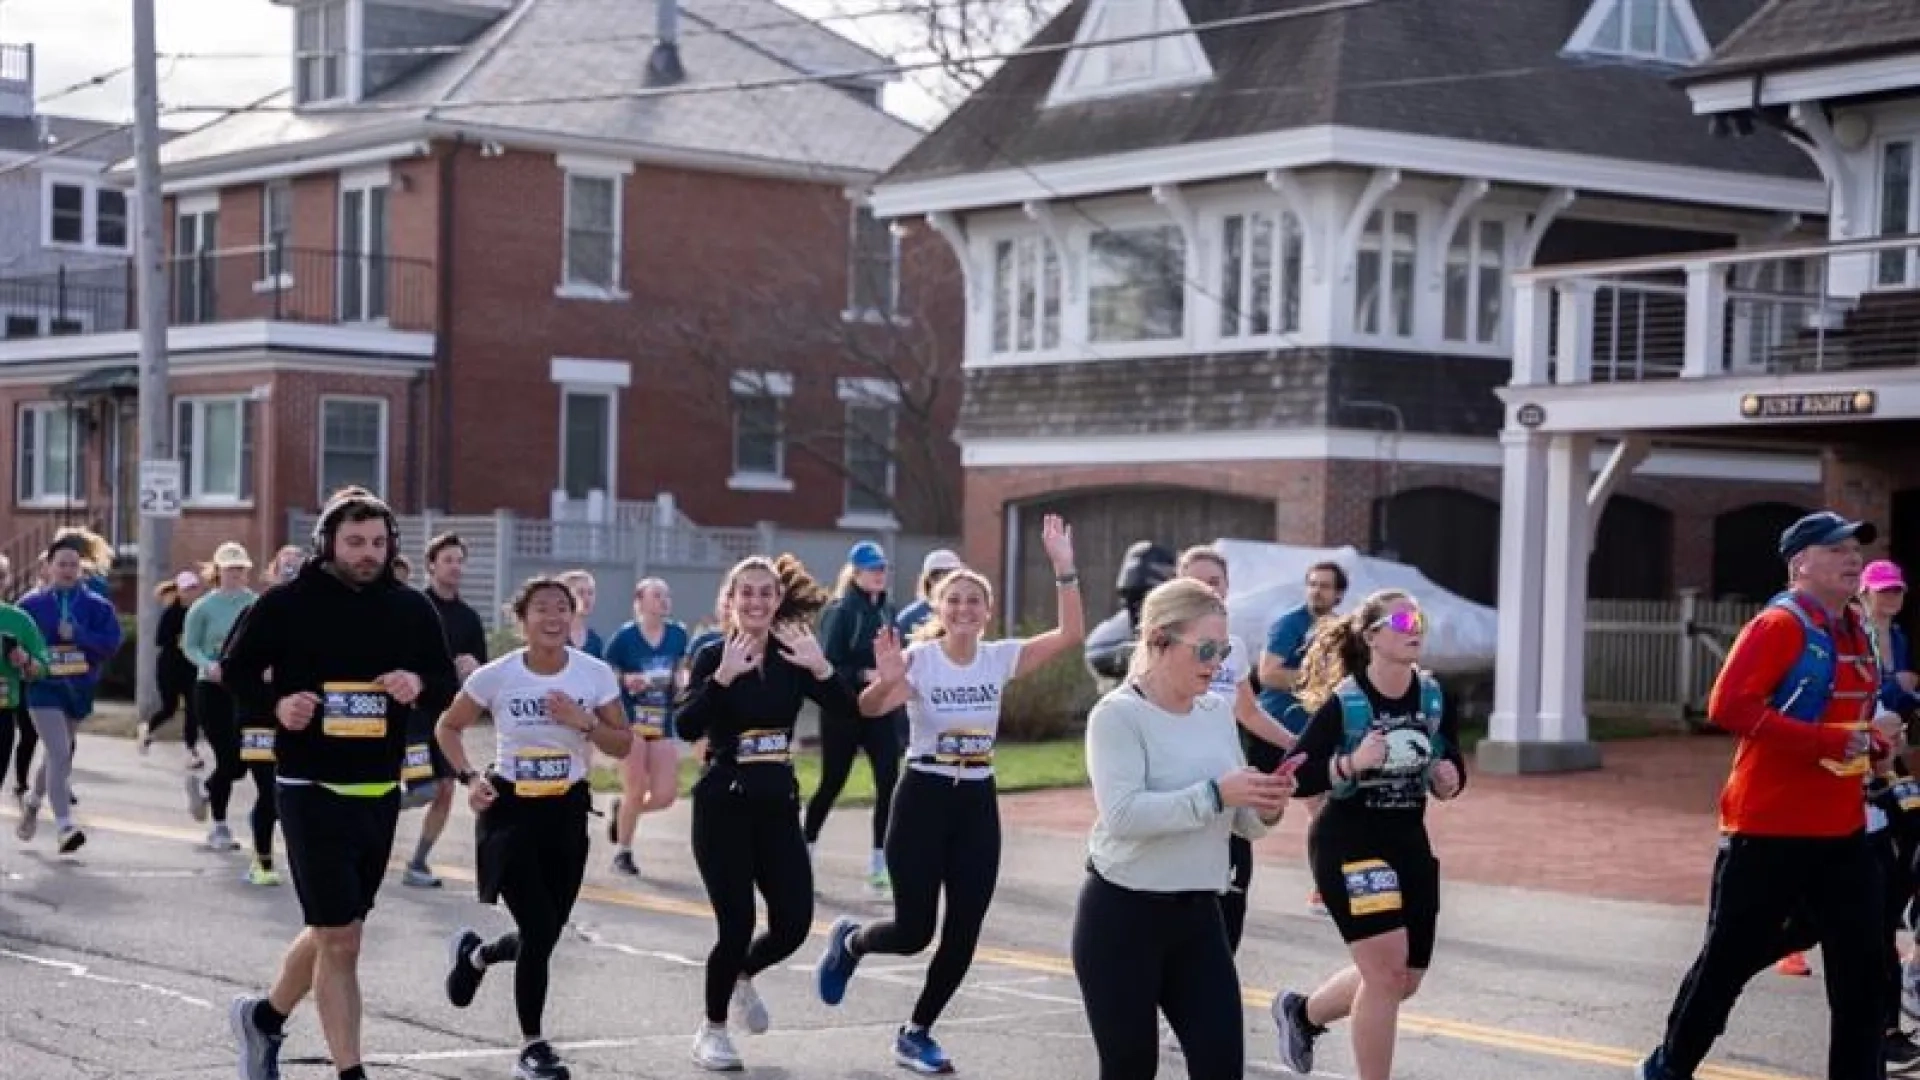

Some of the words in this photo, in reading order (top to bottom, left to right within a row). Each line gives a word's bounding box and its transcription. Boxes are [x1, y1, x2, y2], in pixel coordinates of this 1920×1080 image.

[1763, 397, 1797, 415] JUST
[1803, 394, 1850, 414] RIGHT
[142, 489, 180, 511] 25
